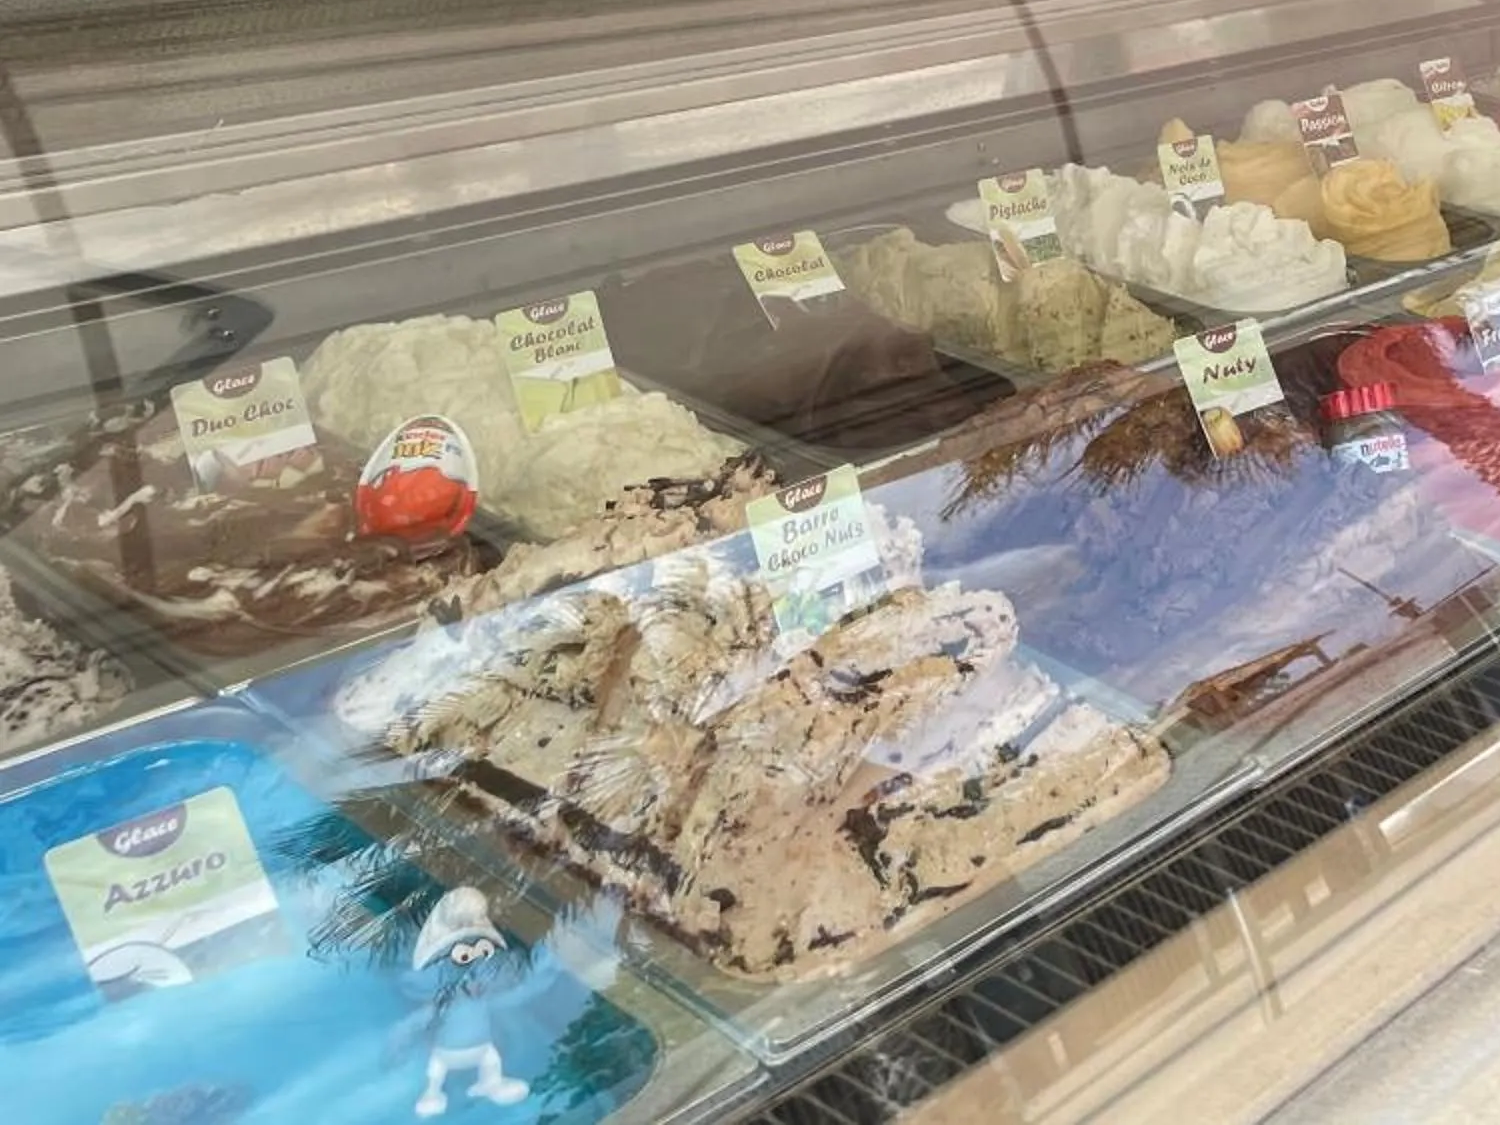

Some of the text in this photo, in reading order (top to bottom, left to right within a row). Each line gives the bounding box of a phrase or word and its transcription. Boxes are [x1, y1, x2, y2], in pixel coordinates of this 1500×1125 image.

[989, 196, 1047, 221] Pistache
[754, 256, 826, 283] Chocolat
[509, 315, 596, 353] Chocolat
[534, 341, 583, 365] Blanc
[1202, 356, 1257, 385] Nuty
[191, 397, 296, 439] Duo Choc
[782, 506, 840, 545] Barre
[767, 521, 866, 573] Choco Nuts
[113, 816, 179, 855] Glace
[103, 850, 227, 914] Azzuro
